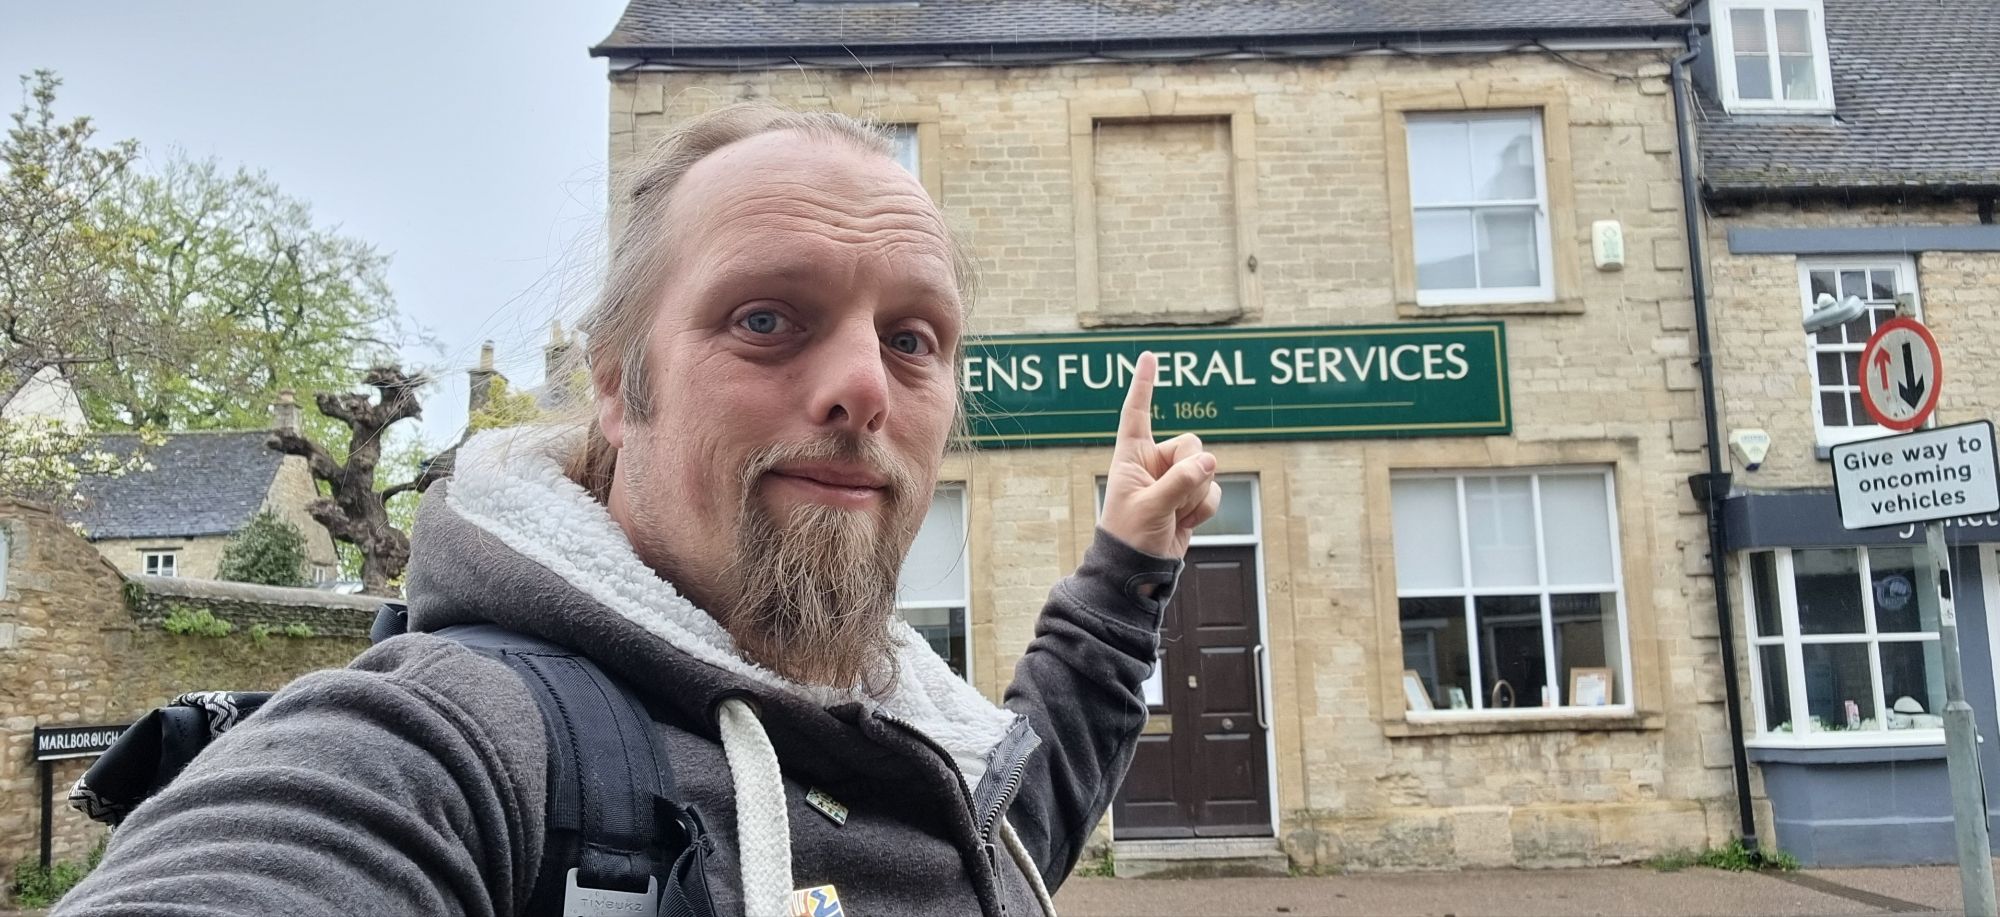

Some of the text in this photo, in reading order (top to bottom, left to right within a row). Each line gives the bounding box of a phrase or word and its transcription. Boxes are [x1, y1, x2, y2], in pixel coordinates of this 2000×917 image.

[1270, 343, 1469, 385] SERVICES
[1173, 401, 1218, 419] 1866
[1844, 436, 1981, 470] Give way to
[1859, 464, 1972, 493] oncoming
[1871, 489, 1966, 514] vehicles
[39, 731, 118, 750] MARLBOROUGH
[580, 898, 643, 912] TIMBUK2
